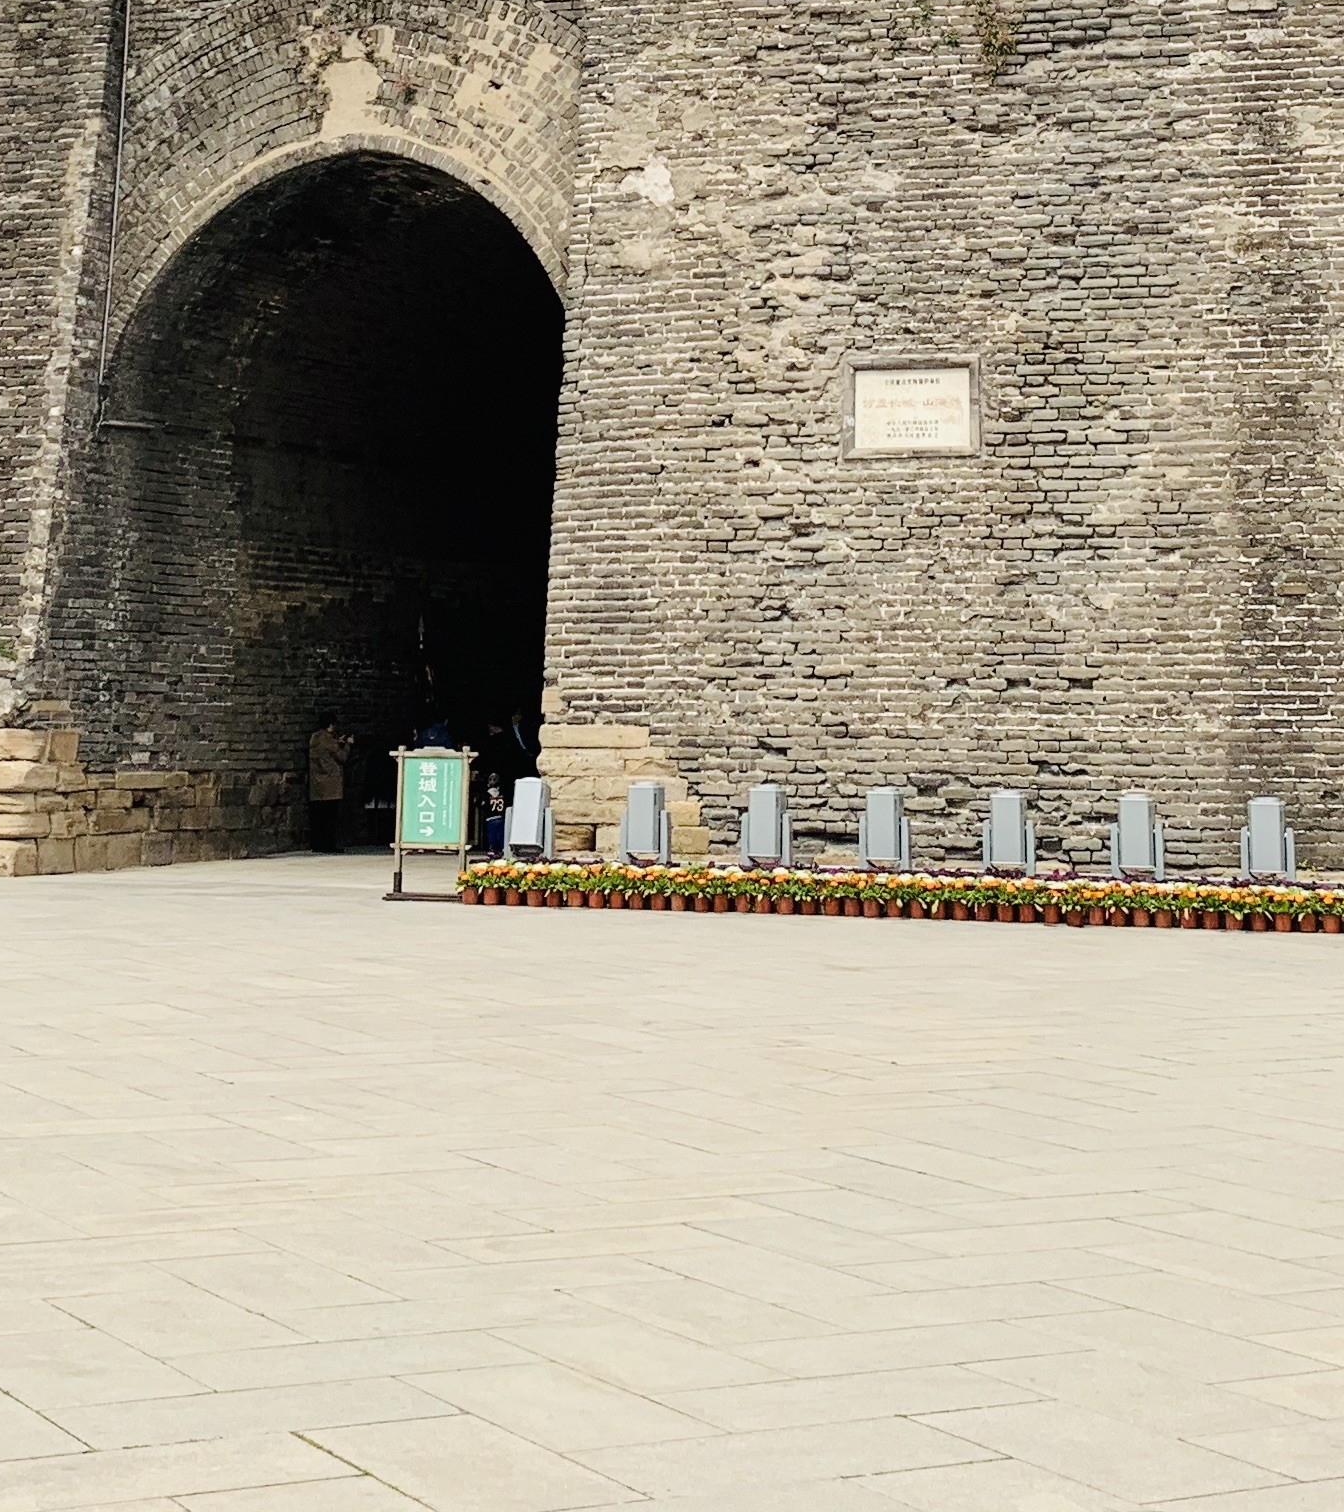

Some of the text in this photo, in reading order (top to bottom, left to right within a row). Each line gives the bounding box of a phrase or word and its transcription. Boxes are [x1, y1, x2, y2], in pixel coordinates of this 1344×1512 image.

[418, 762, 437, 823] 登城入口
[490, 799, 504, 812] 73
